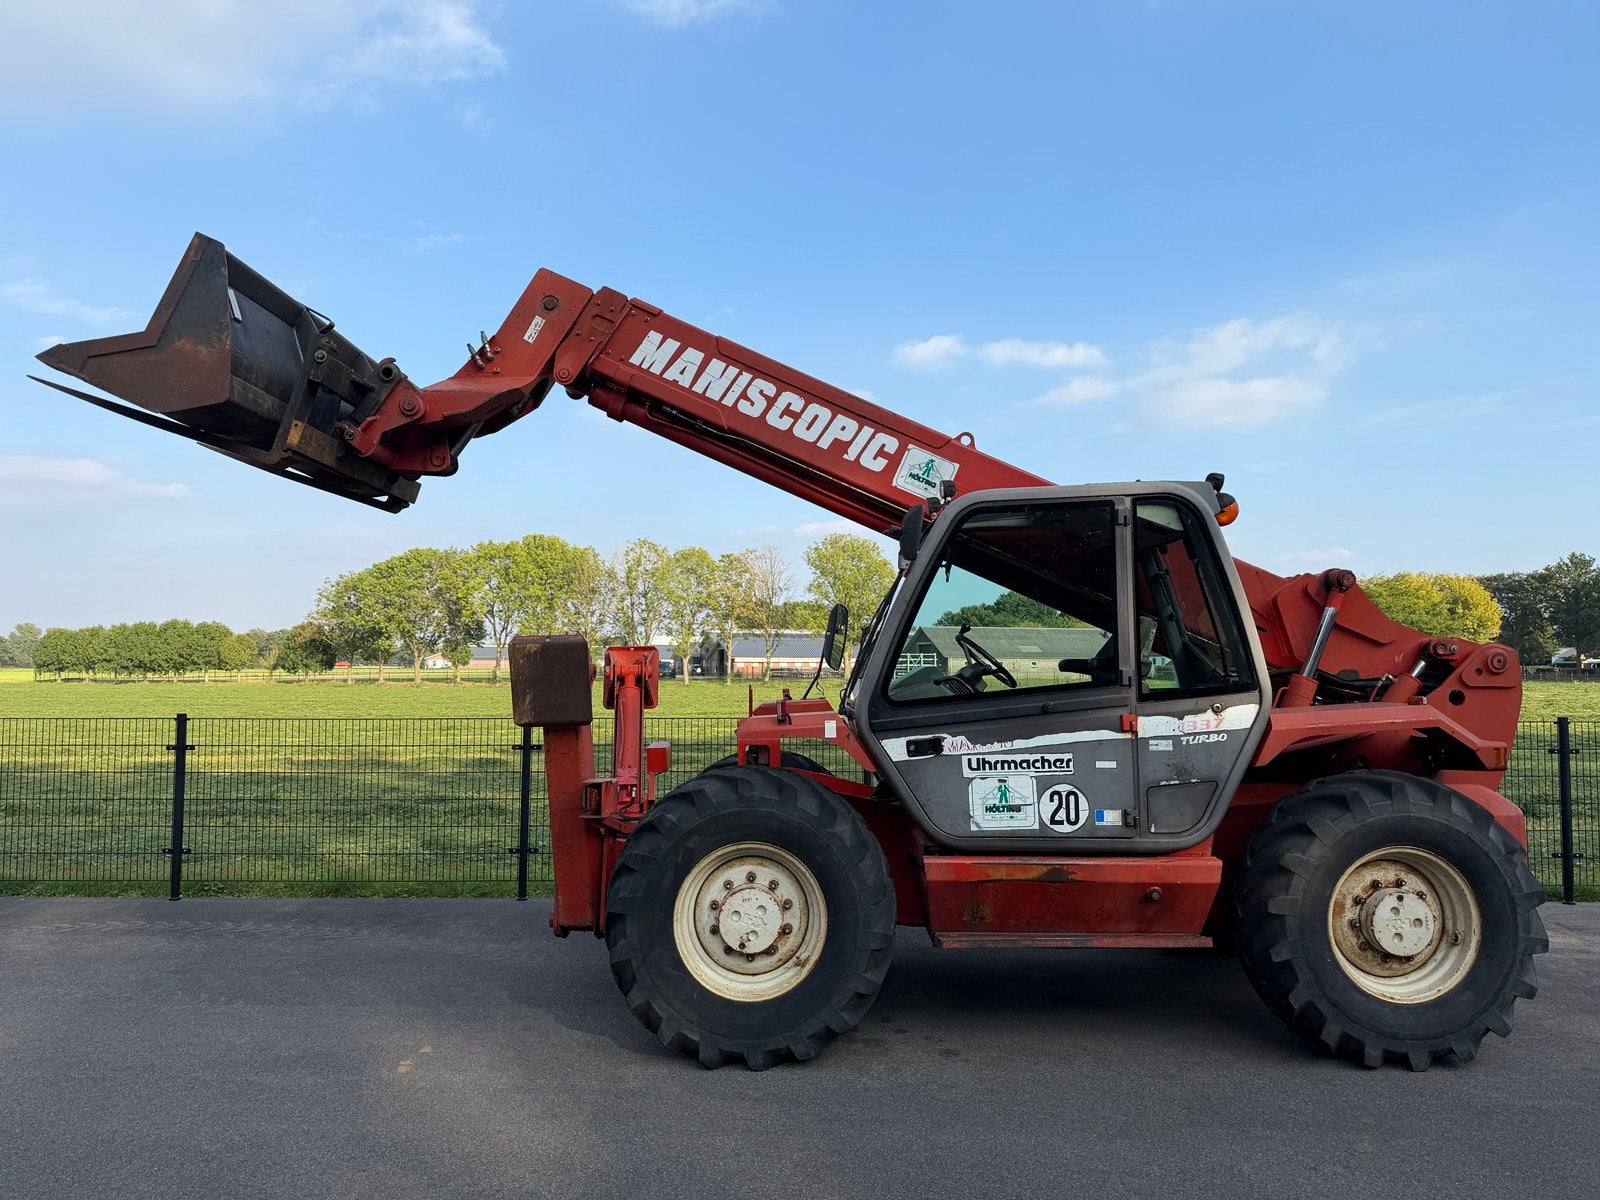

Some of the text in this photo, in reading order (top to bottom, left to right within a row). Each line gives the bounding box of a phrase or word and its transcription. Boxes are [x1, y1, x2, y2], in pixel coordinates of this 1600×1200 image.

[628, 330, 900, 473] MANISCOPIC
[1180, 732, 1228, 746] TURBO
[967, 756, 1073, 772] Uhrmacher
[1049, 790, 1080, 826] 20
